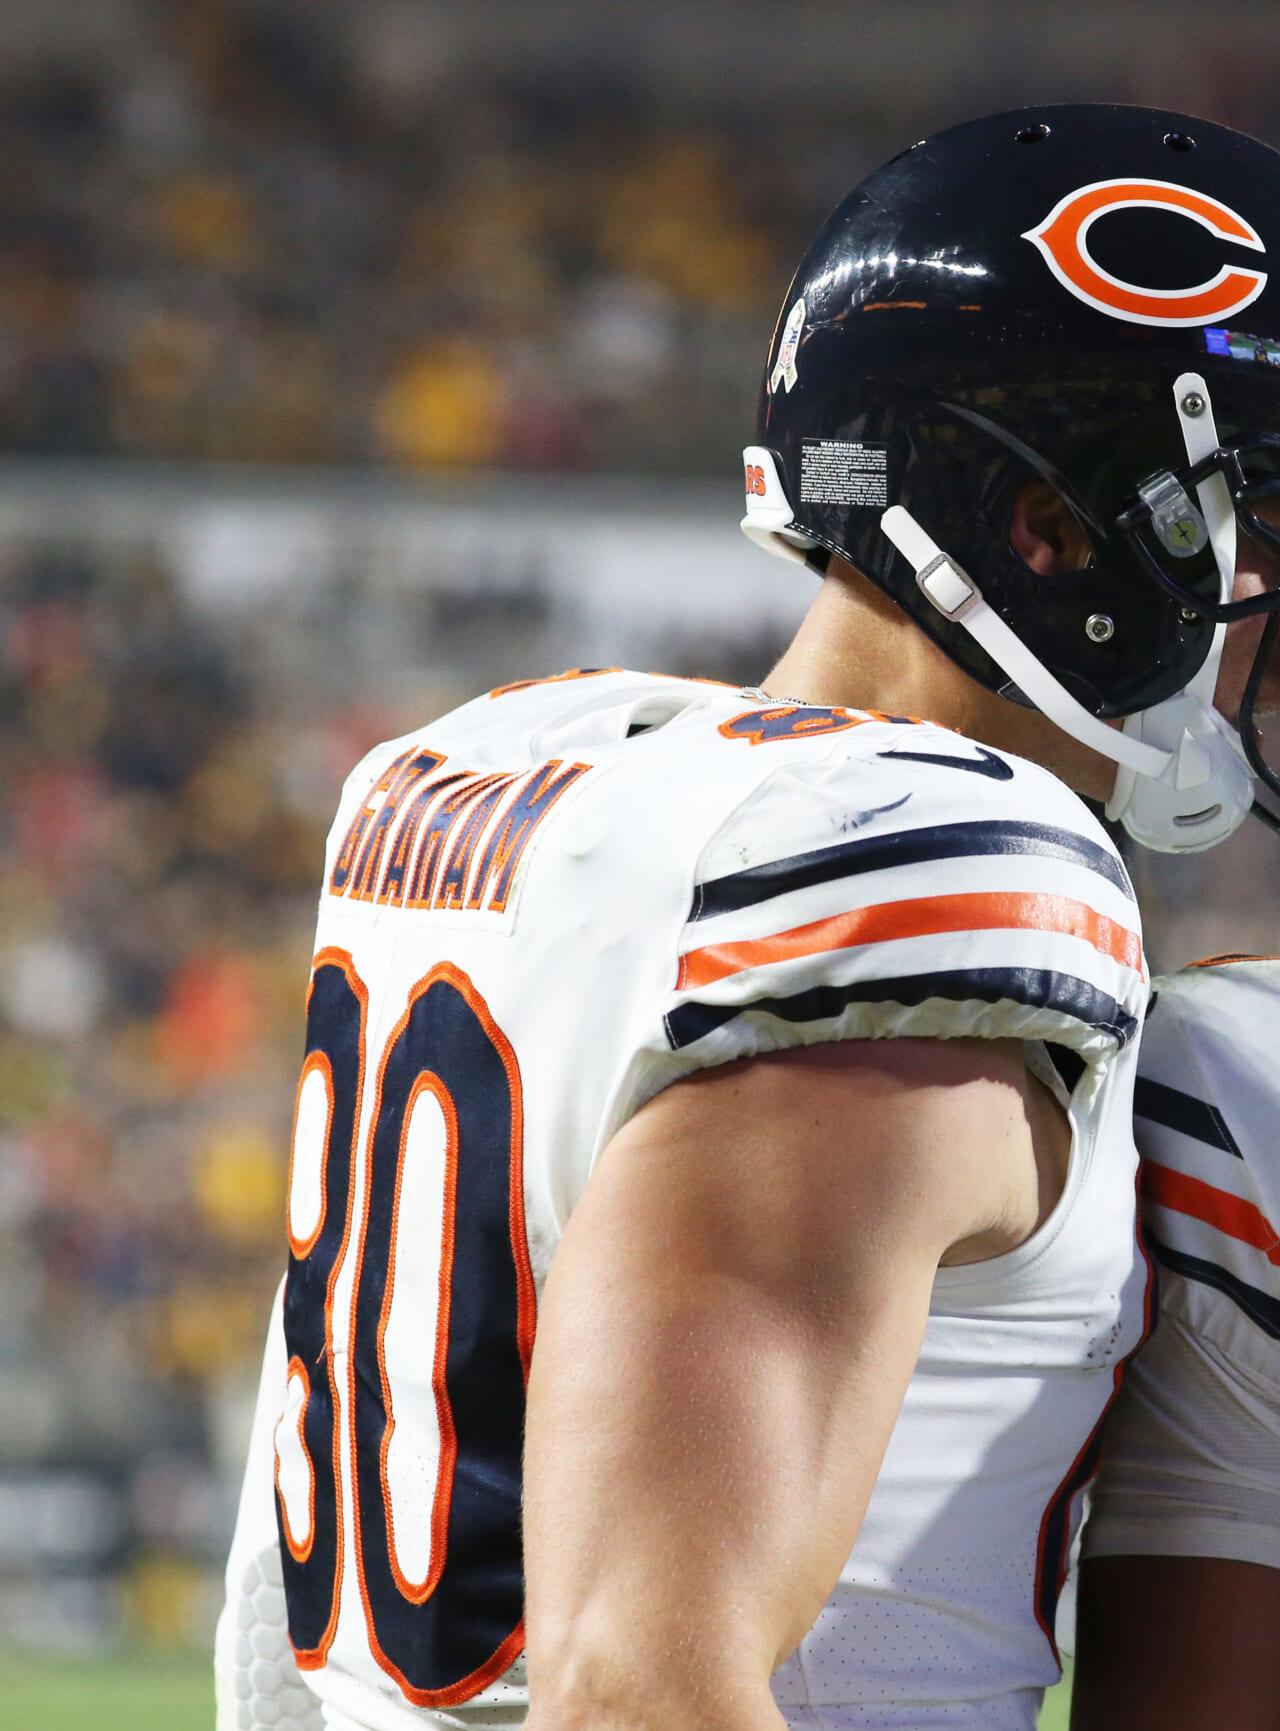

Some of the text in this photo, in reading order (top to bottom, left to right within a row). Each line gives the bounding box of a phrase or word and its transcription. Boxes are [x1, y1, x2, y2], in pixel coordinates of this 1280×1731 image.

[1020, 177, 1268, 328] C
[820, 441, 863, 449] WARNING
[273, 946, 537, 1707] 80
